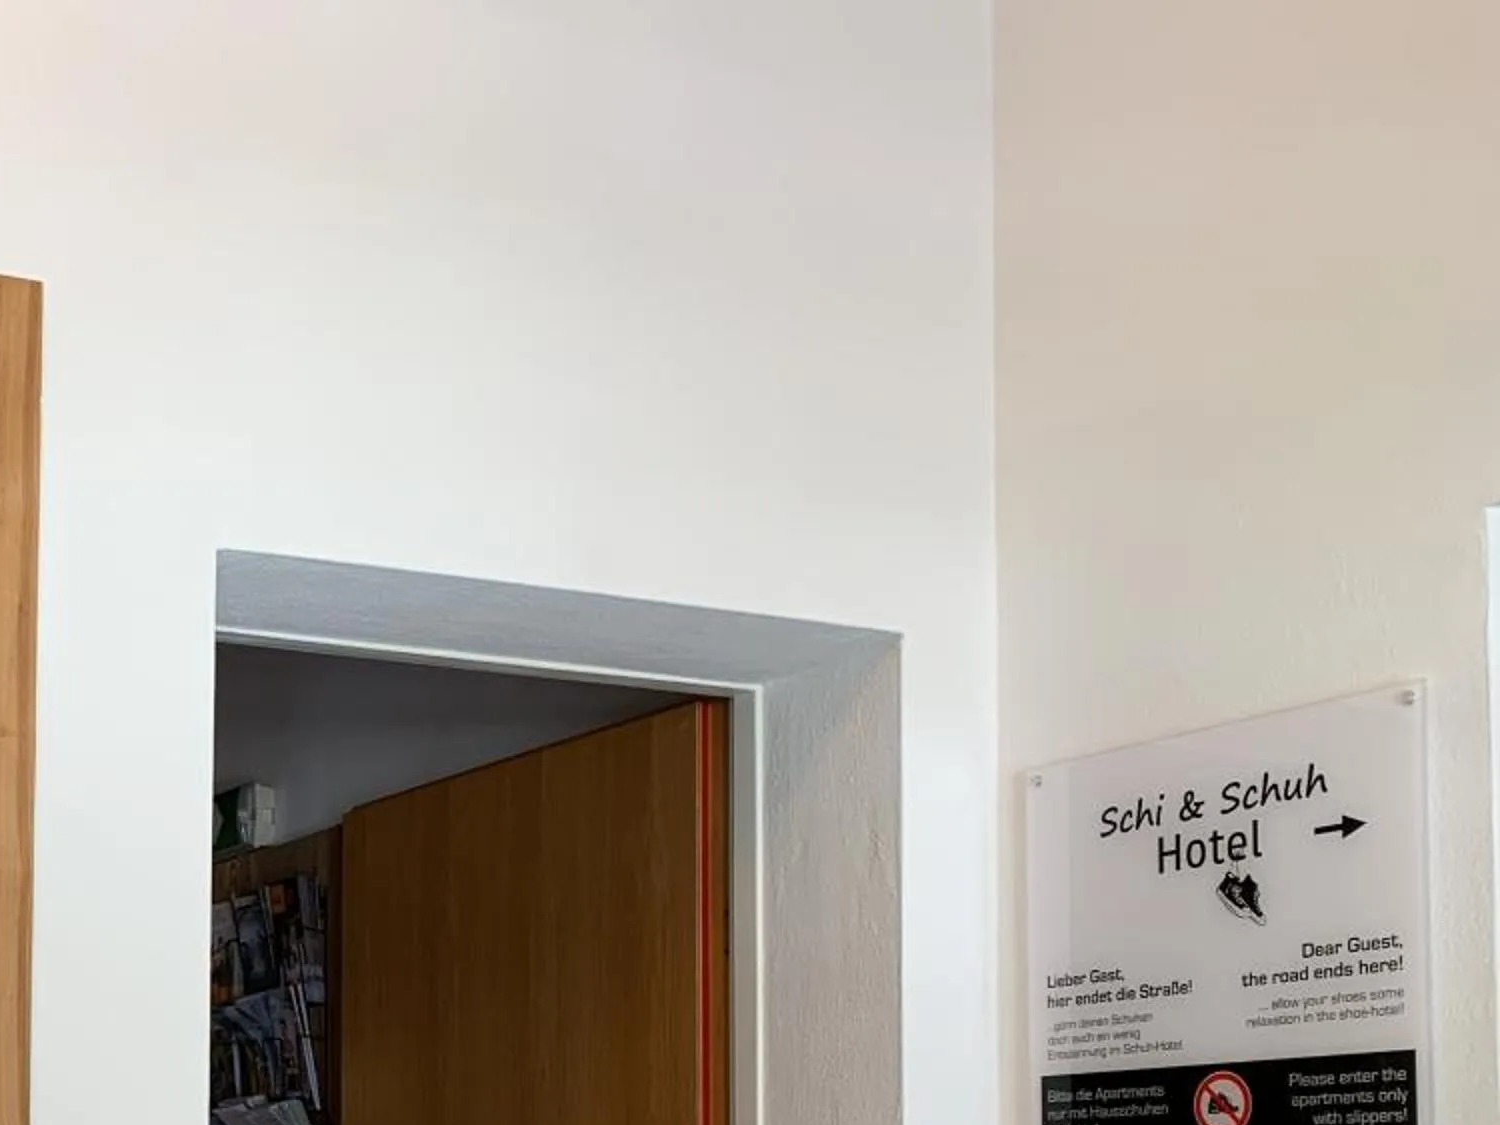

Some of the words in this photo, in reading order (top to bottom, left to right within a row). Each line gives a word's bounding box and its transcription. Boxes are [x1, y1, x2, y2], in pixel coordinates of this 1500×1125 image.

[1100, 794, 1165, 839] Schi
[1179, 791, 1205, 821] &
[1220, 763, 1328, 815] Schuh
[1158, 820, 1262, 875] Hotel
[1301, 943, 1343, 959] Dear
[1347, 935, 1403, 953] Guest,
[1047, 973, 1086, 988] Lieber
[1089, 968, 1125, 984] Gast,
[1241, 972, 1267, 987] the
[1272, 966, 1309, 984] road
[1314, 961, 1354, 980] ends
[1359, 955, 1404, 975] here!
[1047, 993, 1073, 1008] hier
[1075, 989, 1113, 1006] endet
[1115, 987, 1137, 1001] die
[1139, 979, 1193, 999] Straße!
[1272, 997, 1300, 1010] allow
[1303, 995, 1328, 1010] your
[1331, 991, 1366, 1005] shoes
[1369, 987, 1404, 1000] some
[1304, 1012, 1314, 1022] in
[1316, 1010, 1336, 1022] the
[1288, 1071, 1336, 1087] Please
[1340, 1070, 1380, 1085] enter
[1381, 1066, 1407, 1082] the
[1291, 1091, 1375, 1111] apartments
[1379, 1087, 1408, 1105] only
[1312, 1109, 1343, 1125] with
